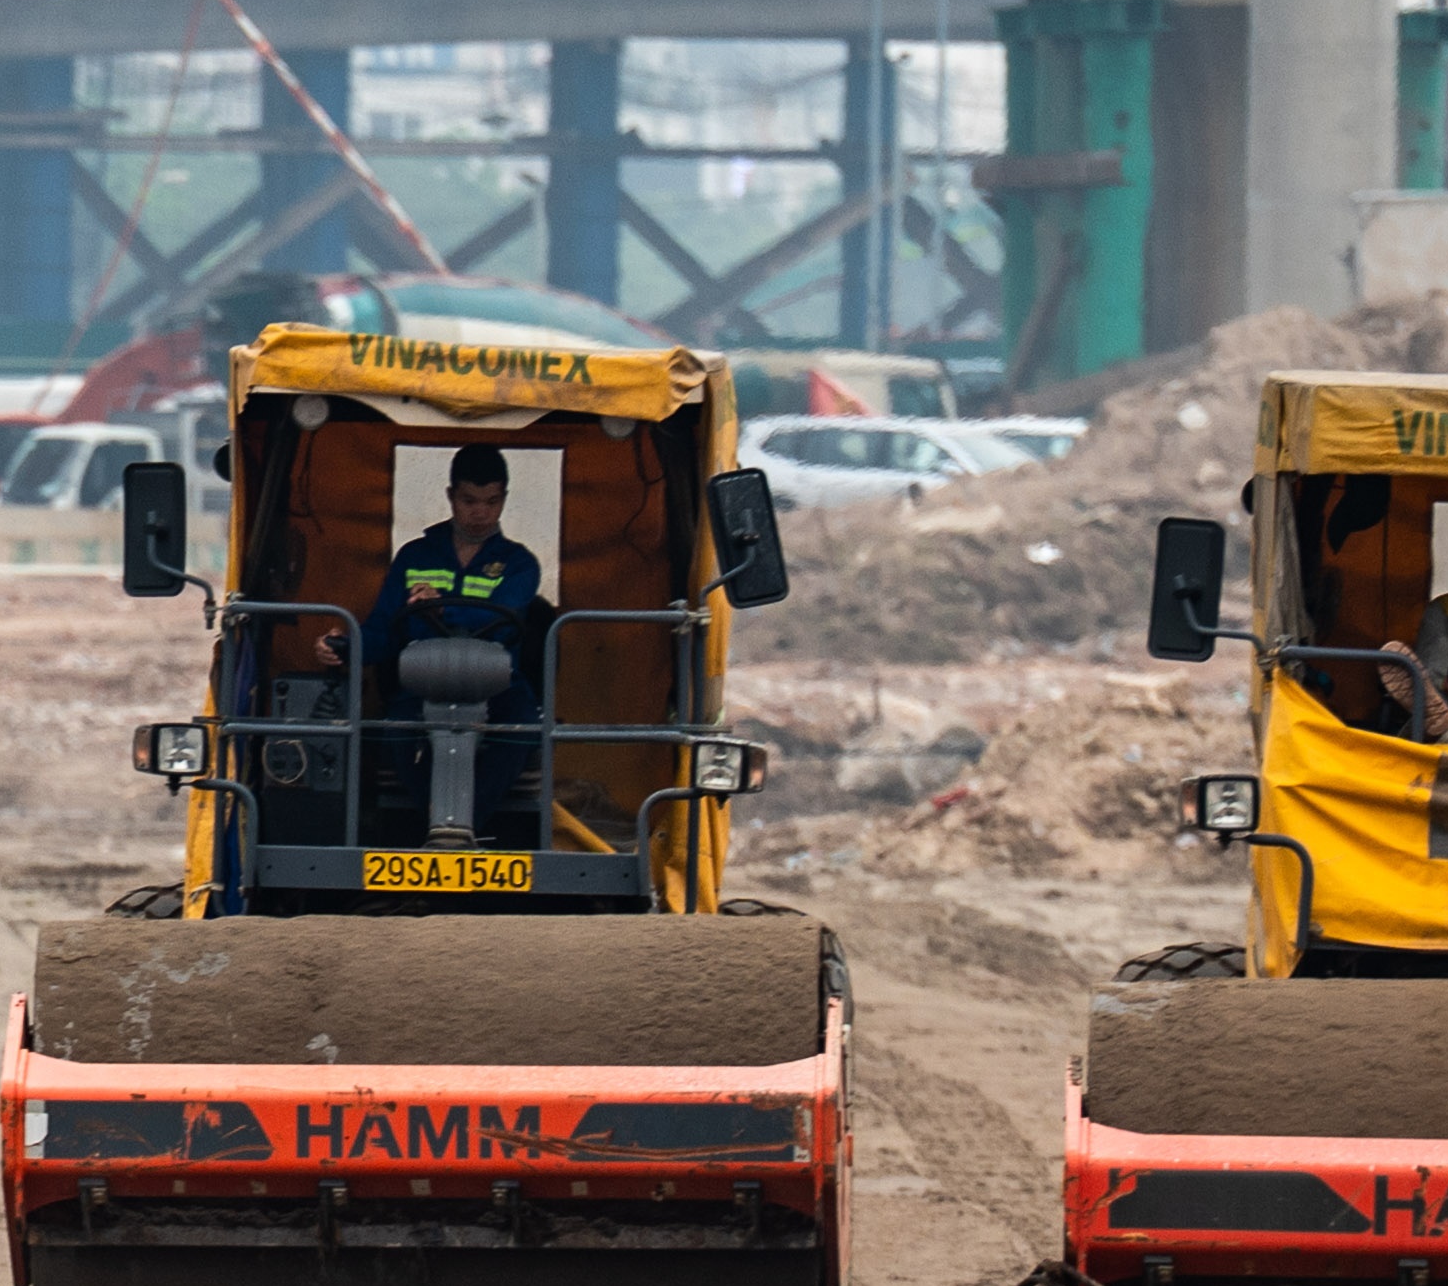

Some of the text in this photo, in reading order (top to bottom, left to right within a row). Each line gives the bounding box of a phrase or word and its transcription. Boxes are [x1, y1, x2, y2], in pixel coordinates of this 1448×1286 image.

[349, 333, 593, 385] VINACONEX
[368, 855, 528, 888] 29SA-1540
[296, 1104, 541, 1159] HAMM
